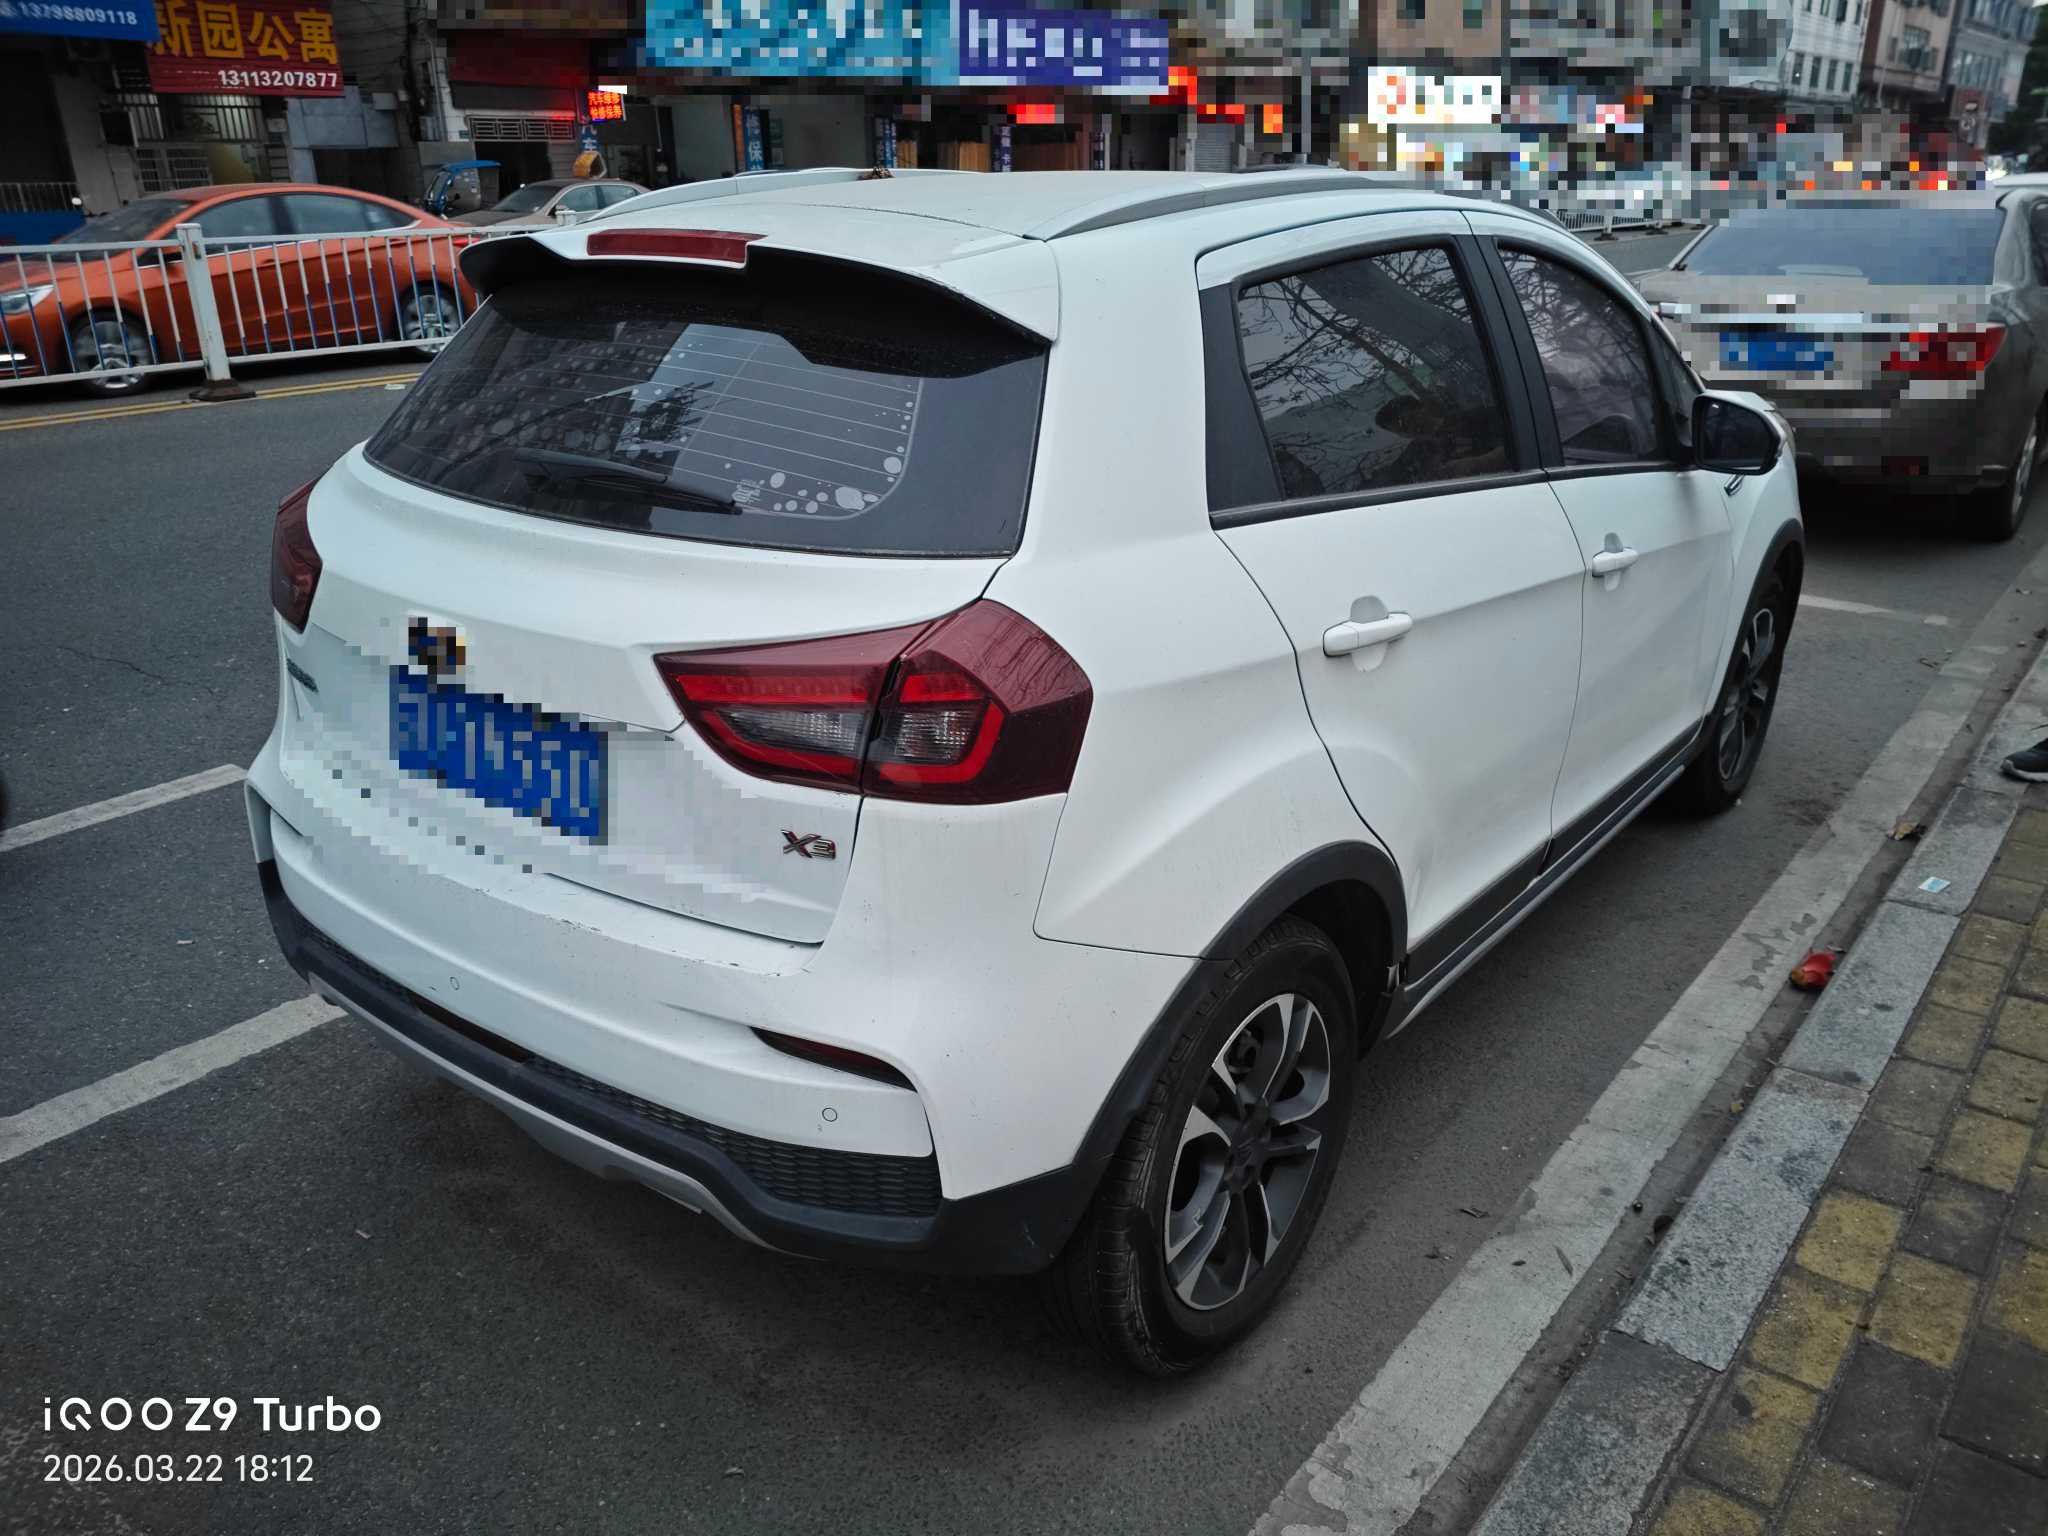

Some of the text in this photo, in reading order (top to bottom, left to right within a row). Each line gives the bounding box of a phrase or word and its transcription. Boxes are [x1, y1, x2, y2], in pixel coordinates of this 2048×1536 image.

[153, 0, 338, 64] 新园公寓
[218, 69, 338, 88] 13113207877
[781, 829, 836, 860] X3
